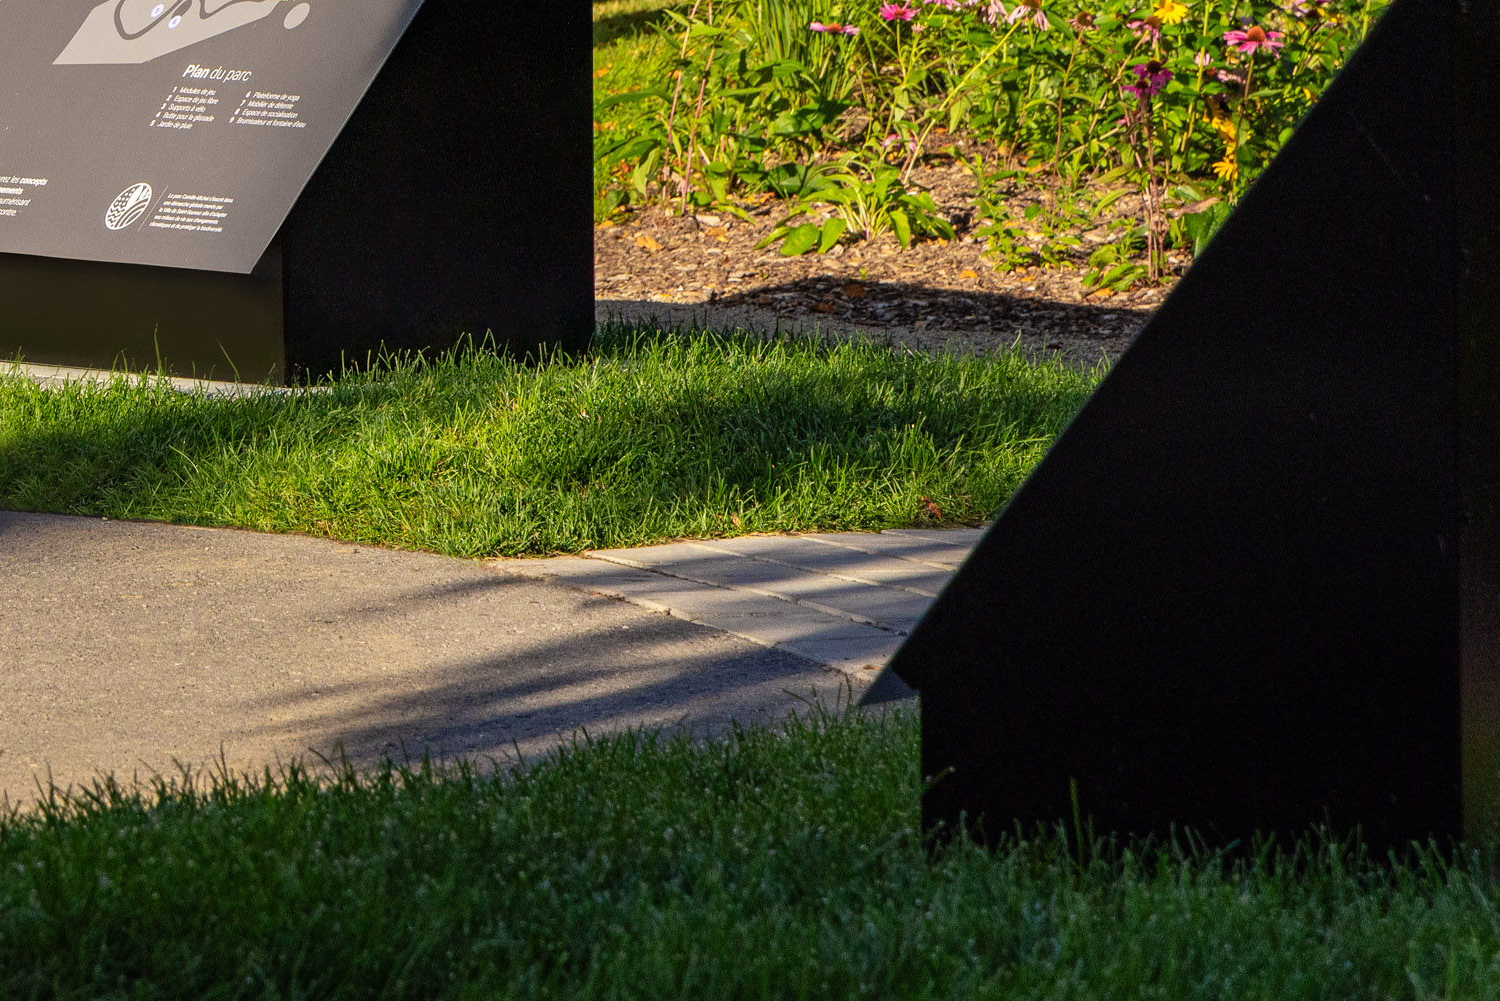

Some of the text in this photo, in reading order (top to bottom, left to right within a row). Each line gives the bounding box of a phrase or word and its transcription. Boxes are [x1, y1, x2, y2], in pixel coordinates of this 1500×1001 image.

[182, 64, 252, 83] Plan du parc
